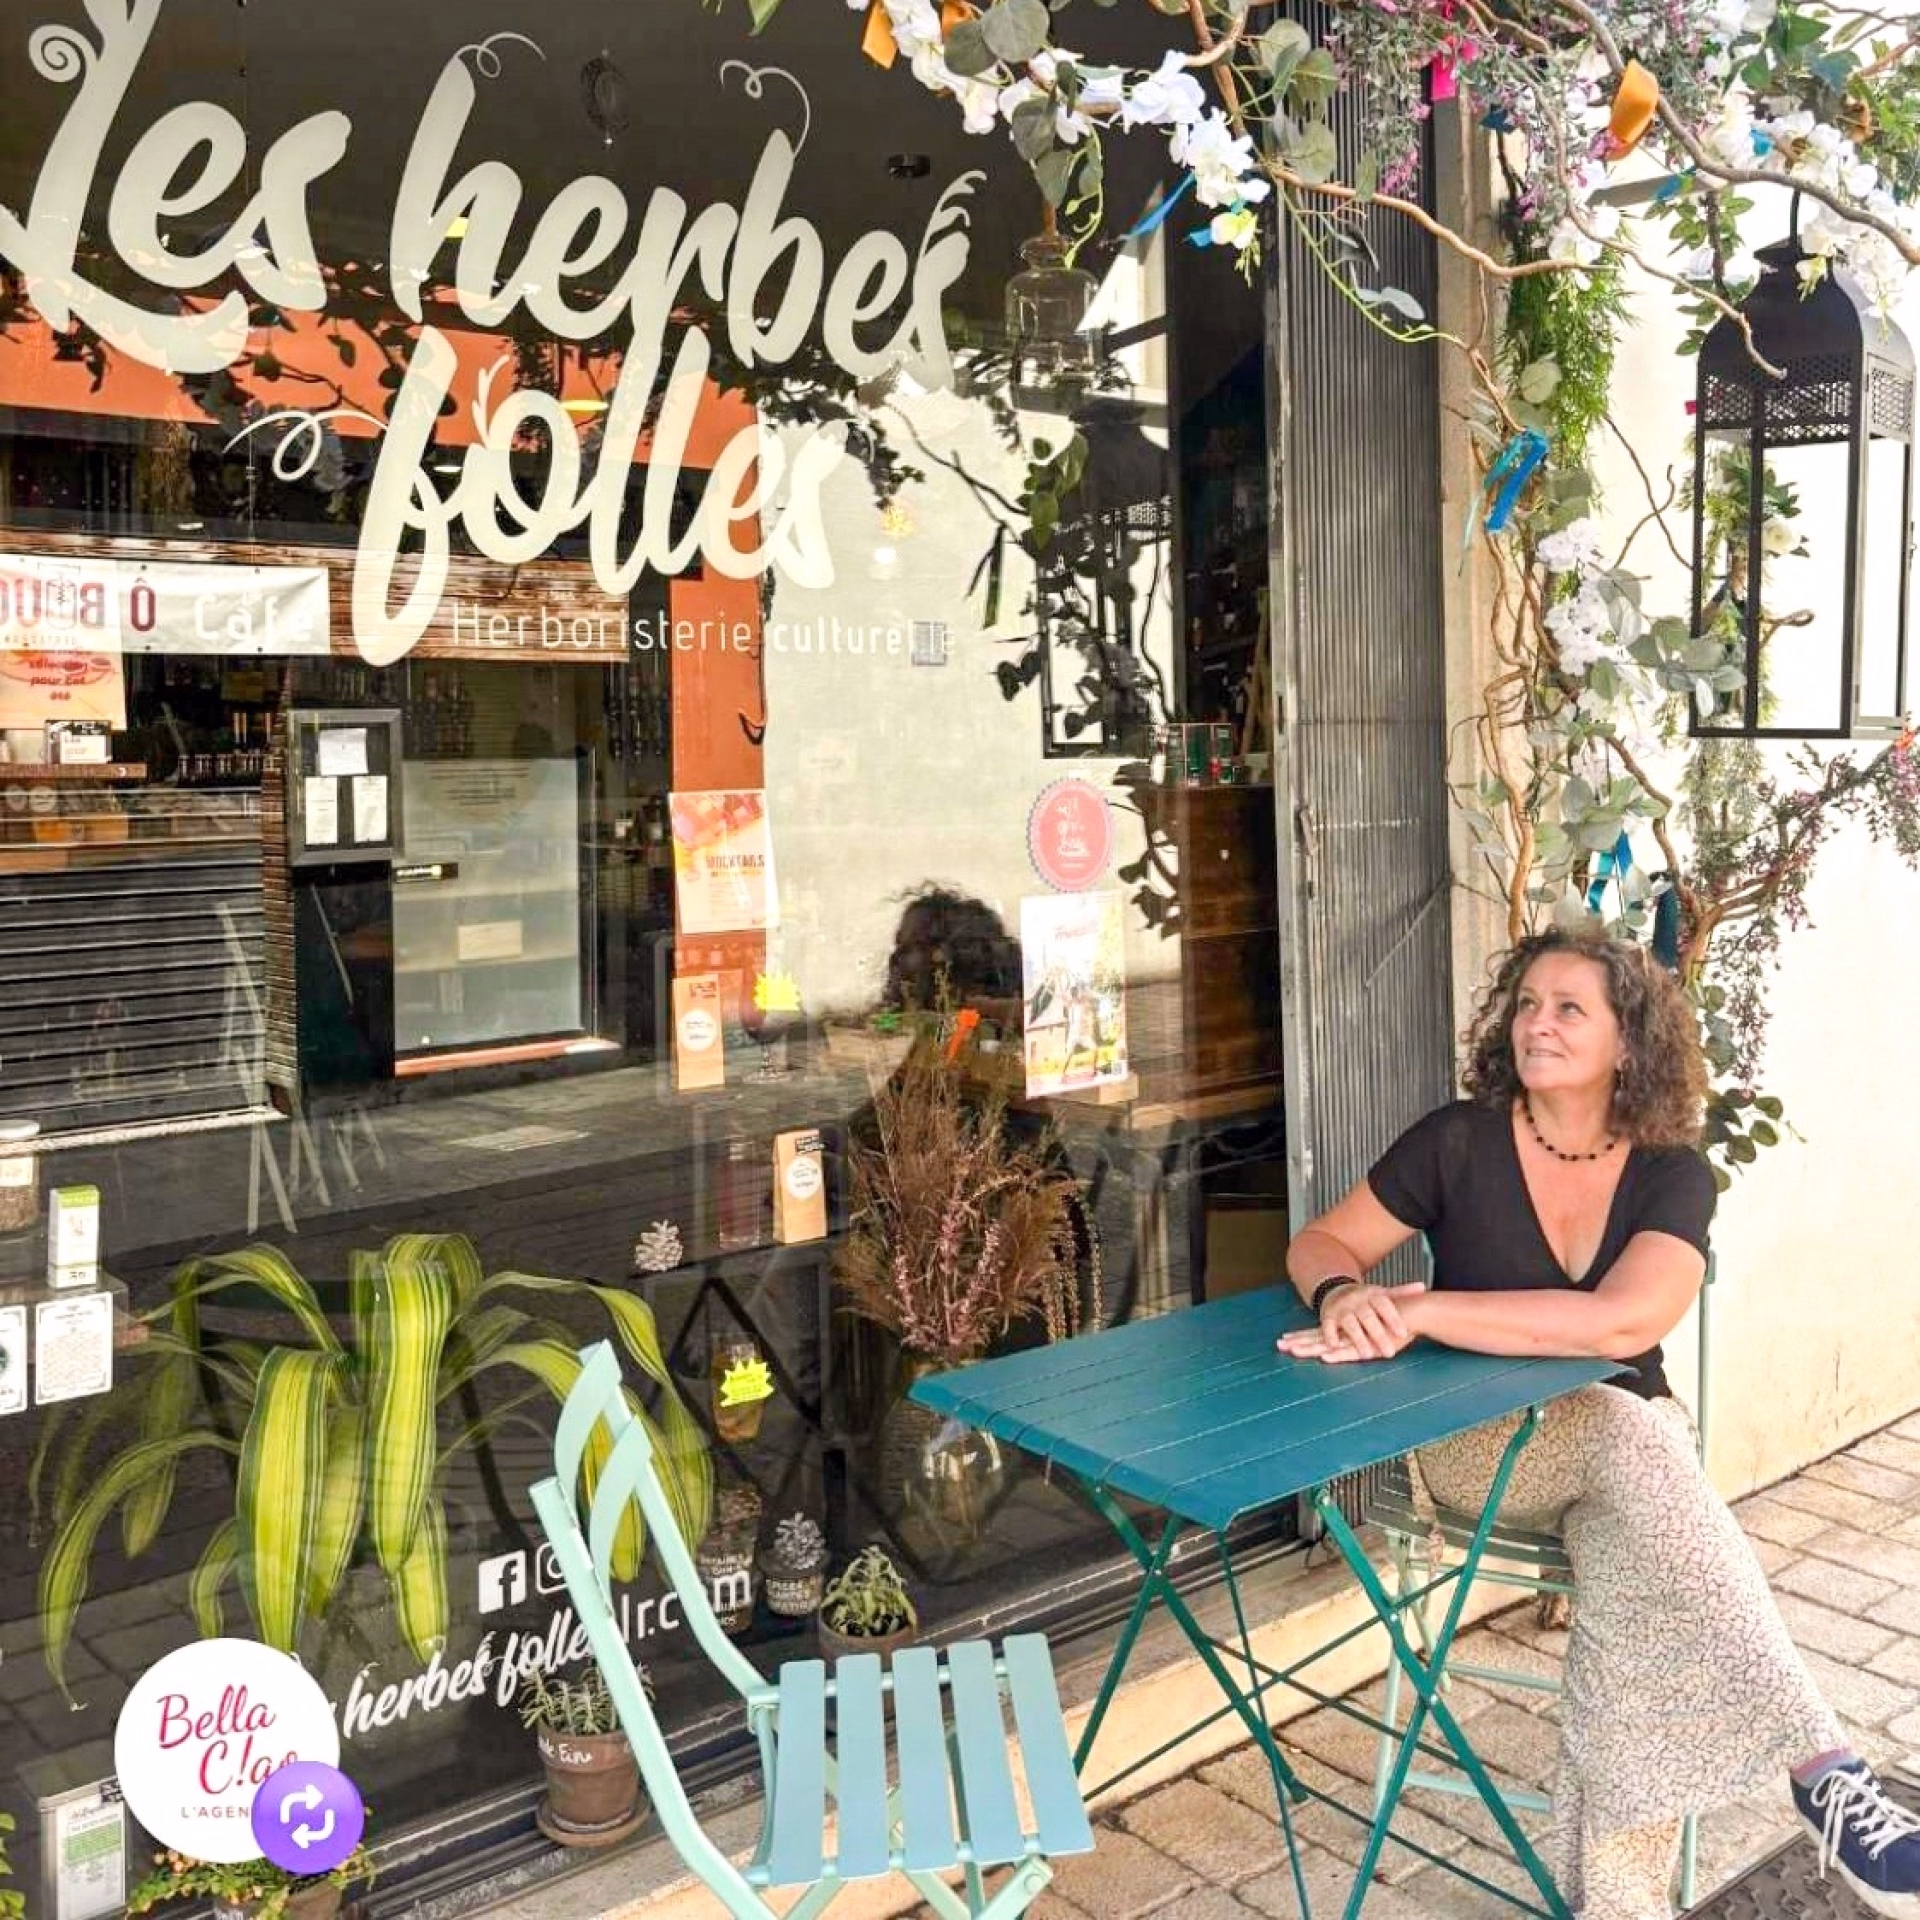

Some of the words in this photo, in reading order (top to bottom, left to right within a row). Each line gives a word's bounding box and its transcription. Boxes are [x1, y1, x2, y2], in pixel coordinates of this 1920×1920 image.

[0, 0, 352, 374] Les
[388, 45, 988, 392] herbes
[350, 325, 852, 667] folles
[451, 603, 752, 651] Herboristerie
[772, 616, 955, 655] culturelle
[343, 1630, 498, 1740] herbes
[496, 1607, 602, 1707] folle
